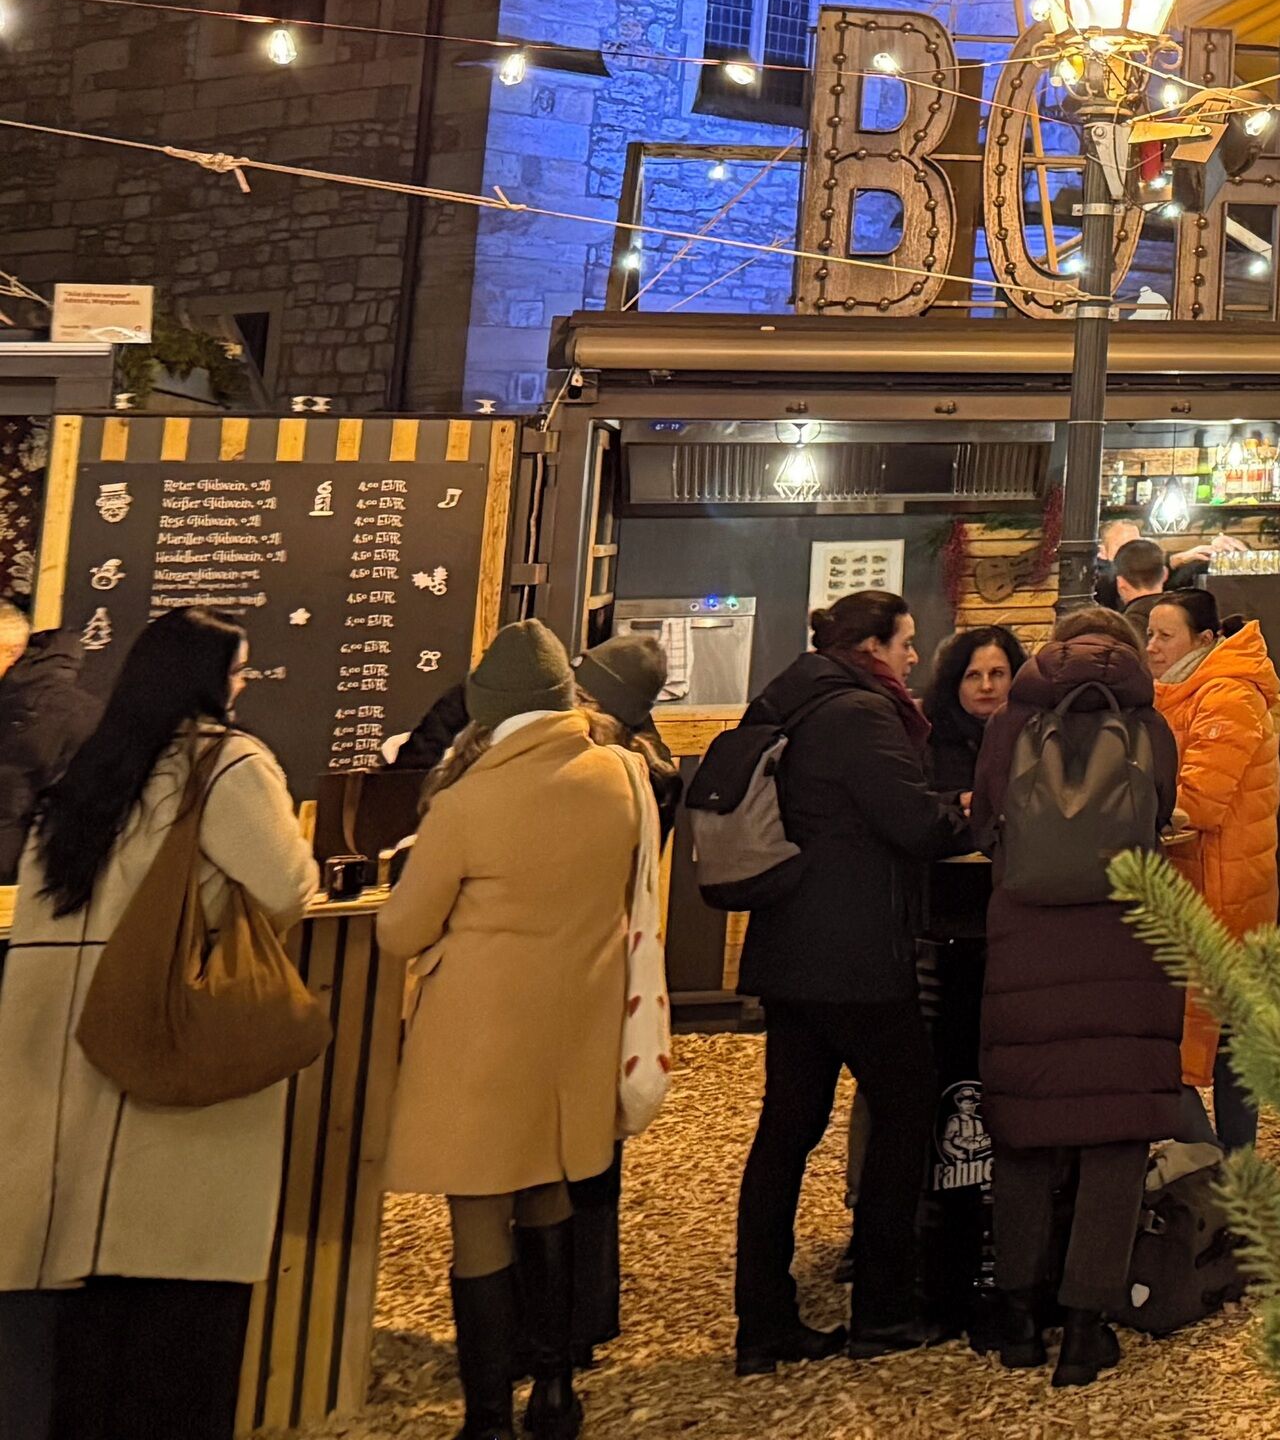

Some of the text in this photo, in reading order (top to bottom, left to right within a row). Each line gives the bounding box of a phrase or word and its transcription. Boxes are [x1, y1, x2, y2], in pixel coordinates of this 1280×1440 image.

[381, 479, 408, 493] EUR
[379, 497, 407, 510] EUR
[377, 514, 404, 528] EUR
[375, 531, 402, 545] EUR
[373, 549, 401, 562] EUR
[372, 566, 399, 580] EUR
[369, 590, 397, 604] EUR
[367, 614, 395, 628] EUR
[363, 640, 392, 654] EUR
[362, 663, 390, 677] EUR
[360, 678, 388, 692] EUR
[357, 705, 386, 719] EUR
[355, 723, 384, 737] EUR
[354, 738, 382, 752] EUR
[352, 754, 380, 768] EUR
[933, 1157, 996, 1192] Fahne
